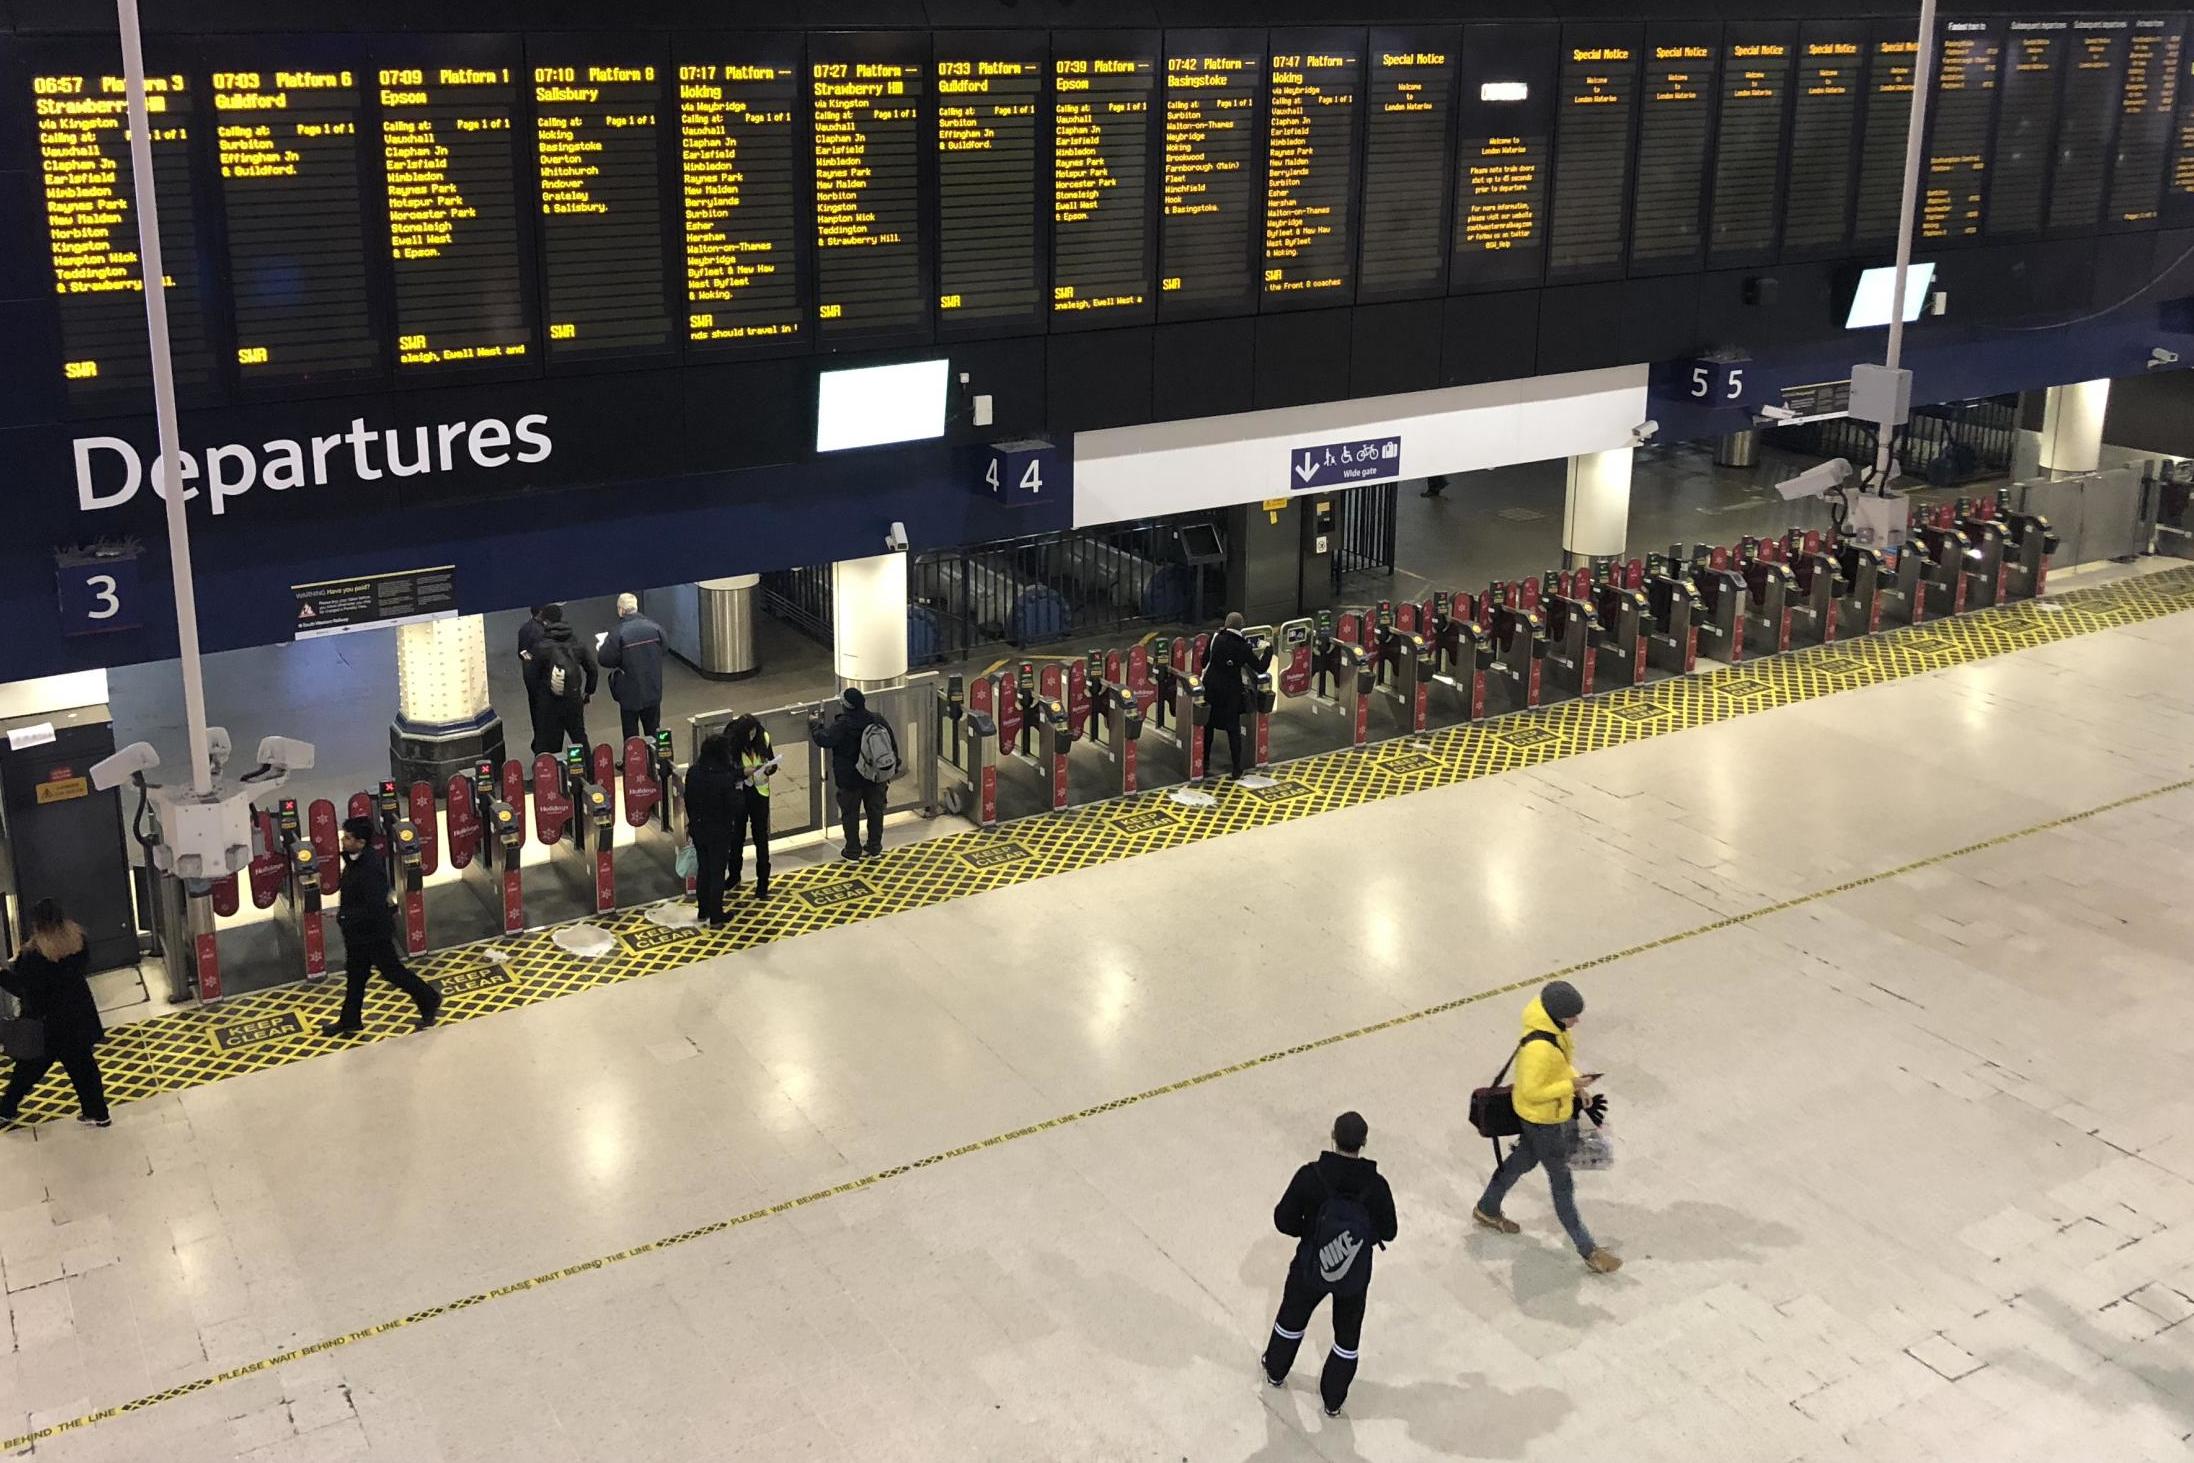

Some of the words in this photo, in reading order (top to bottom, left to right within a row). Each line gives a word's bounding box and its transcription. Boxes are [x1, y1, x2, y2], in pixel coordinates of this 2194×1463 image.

[1057, 61, 1087, 73] 07:39
[1095, 61, 1134, 72] Platform
[1169, 59, 1197, 70] 07:42
[1204, 58, 1241, 69] Platform
[1274, 56, 1300, 67] 07:47
[1307, 56, 1342, 67] Platform
[380, 70, 422, 85] 07:09
[440, 69, 496, 83] Platform
[503, 69, 508, 82] 1
[535, 68, 574, 82] 07:10
[589, 68, 641, 81] Platform
[645, 67, 654, 80] 8
[680, 67, 715, 80] 07:17
[726, 66, 774, 79] Platform
[814, 65, 847, 77] 07:27
[857, 64, 901, 77] Platform
[34, 77, 83, 93] 06:57
[171, 75, 184, 91] 3
[1057, 78, 1089, 91] Epsom
[1168, 75, 1227, 87] Basingstoke
[1273, 72, 1302, 84] Woking
[681, 85, 721, 99] Woking
[939, 80, 988, 92] Guildford
[381, 90, 427, 106] Epsom
[536, 87, 598, 102] Salisbury
[37, 98, 130, 115] Strawberr
[39, 119, 57, 129] via
[59, 117, 118, 131] Kingston
[539, 130, 573, 141] Woking
[219, 139, 274, 150] Surbiton
[539, 141, 602, 153] Basingstoke
[541, 155, 581, 164] Overton
[45, 172, 115, 185] Earlsfield
[542, 180, 583, 188] Andover
[47, 186, 112, 198] Wimbledon
[48, 201, 94, 214] Raynes
[97, 199, 127, 210] Park
[389, 196, 433, 208] Motspur
[438, 196, 462, 206] Park
[49, 215, 73, 225] New
[77, 213, 122, 224] Malden
[390, 210, 447, 221] Worcester
[451, 208, 475, 217] Park
[51, 227, 108, 239] Norbiton
[391, 221, 452, 233] Stoneleigh
[392, 235, 422, 246] Ewell
[427, 234, 452, 243] West
[53, 241, 110, 254] Kingston
[54, 254, 105, 267] Hampton
[108, 252, 137, 263] Wick
[56, 267, 127, 279] Teddington
[820, 305, 841, 317] SWR
[690, 315, 712, 328] SWR
[551, 325, 575, 338] SWR
[400, 335, 426, 350] SWR
[239, 348, 267, 363] SWR
[65, 361, 97, 378] SWR
[1691, 368, 1708, 397] 5
[1727, 370, 1743, 399] 5
[73, 413, 552, 515] Departures
[986, 458, 1000, 492] 4
[1020, 459, 1042, 493] 4
[1362, 467, 1377, 477] gate
[86, 574, 120, 619] 3
[812, 880, 855, 898] KEEP
[814, 887, 868, 905] CLEAR
[636, 930, 695, 949] CLEAR
[440, 970, 491, 988] KEEP
[441, 975, 505, 996] CLEAR
[229, 1017, 284, 1036] KEEP
[226, 1024, 295, 1047] CLEAR
[730, 1209, 768, 1225] PLEASE
[769, 1202, 794, 1213] WAIT
[796, 1190, 832, 1206] BEHIND
[833, 1183, 853, 1194] THE
[855, 1176, 876, 1187] LINE
[1319, 1230, 1353, 1270] NIKE
[490, 1280, 531, 1298] PLEASE
[534, 1271, 561, 1284] WAIT
[564, 1259, 602, 1276] BEHIND
[606, 1252, 627, 1263] THE
[629, 1244, 653, 1256] LINE
[218, 1361, 265, 1382] PLEASE
[268, 1351, 298, 1366] WAIT
[301, 1337, 345, 1356] BEHIND
[349, 1328, 372, 1341] THE
[376, 1319, 401, 1333] LINE
[3, 1428, 53, 1449] BEHIND
[58, 1418, 83, 1433] THE
[88, 1408, 117, 1423] LINE
